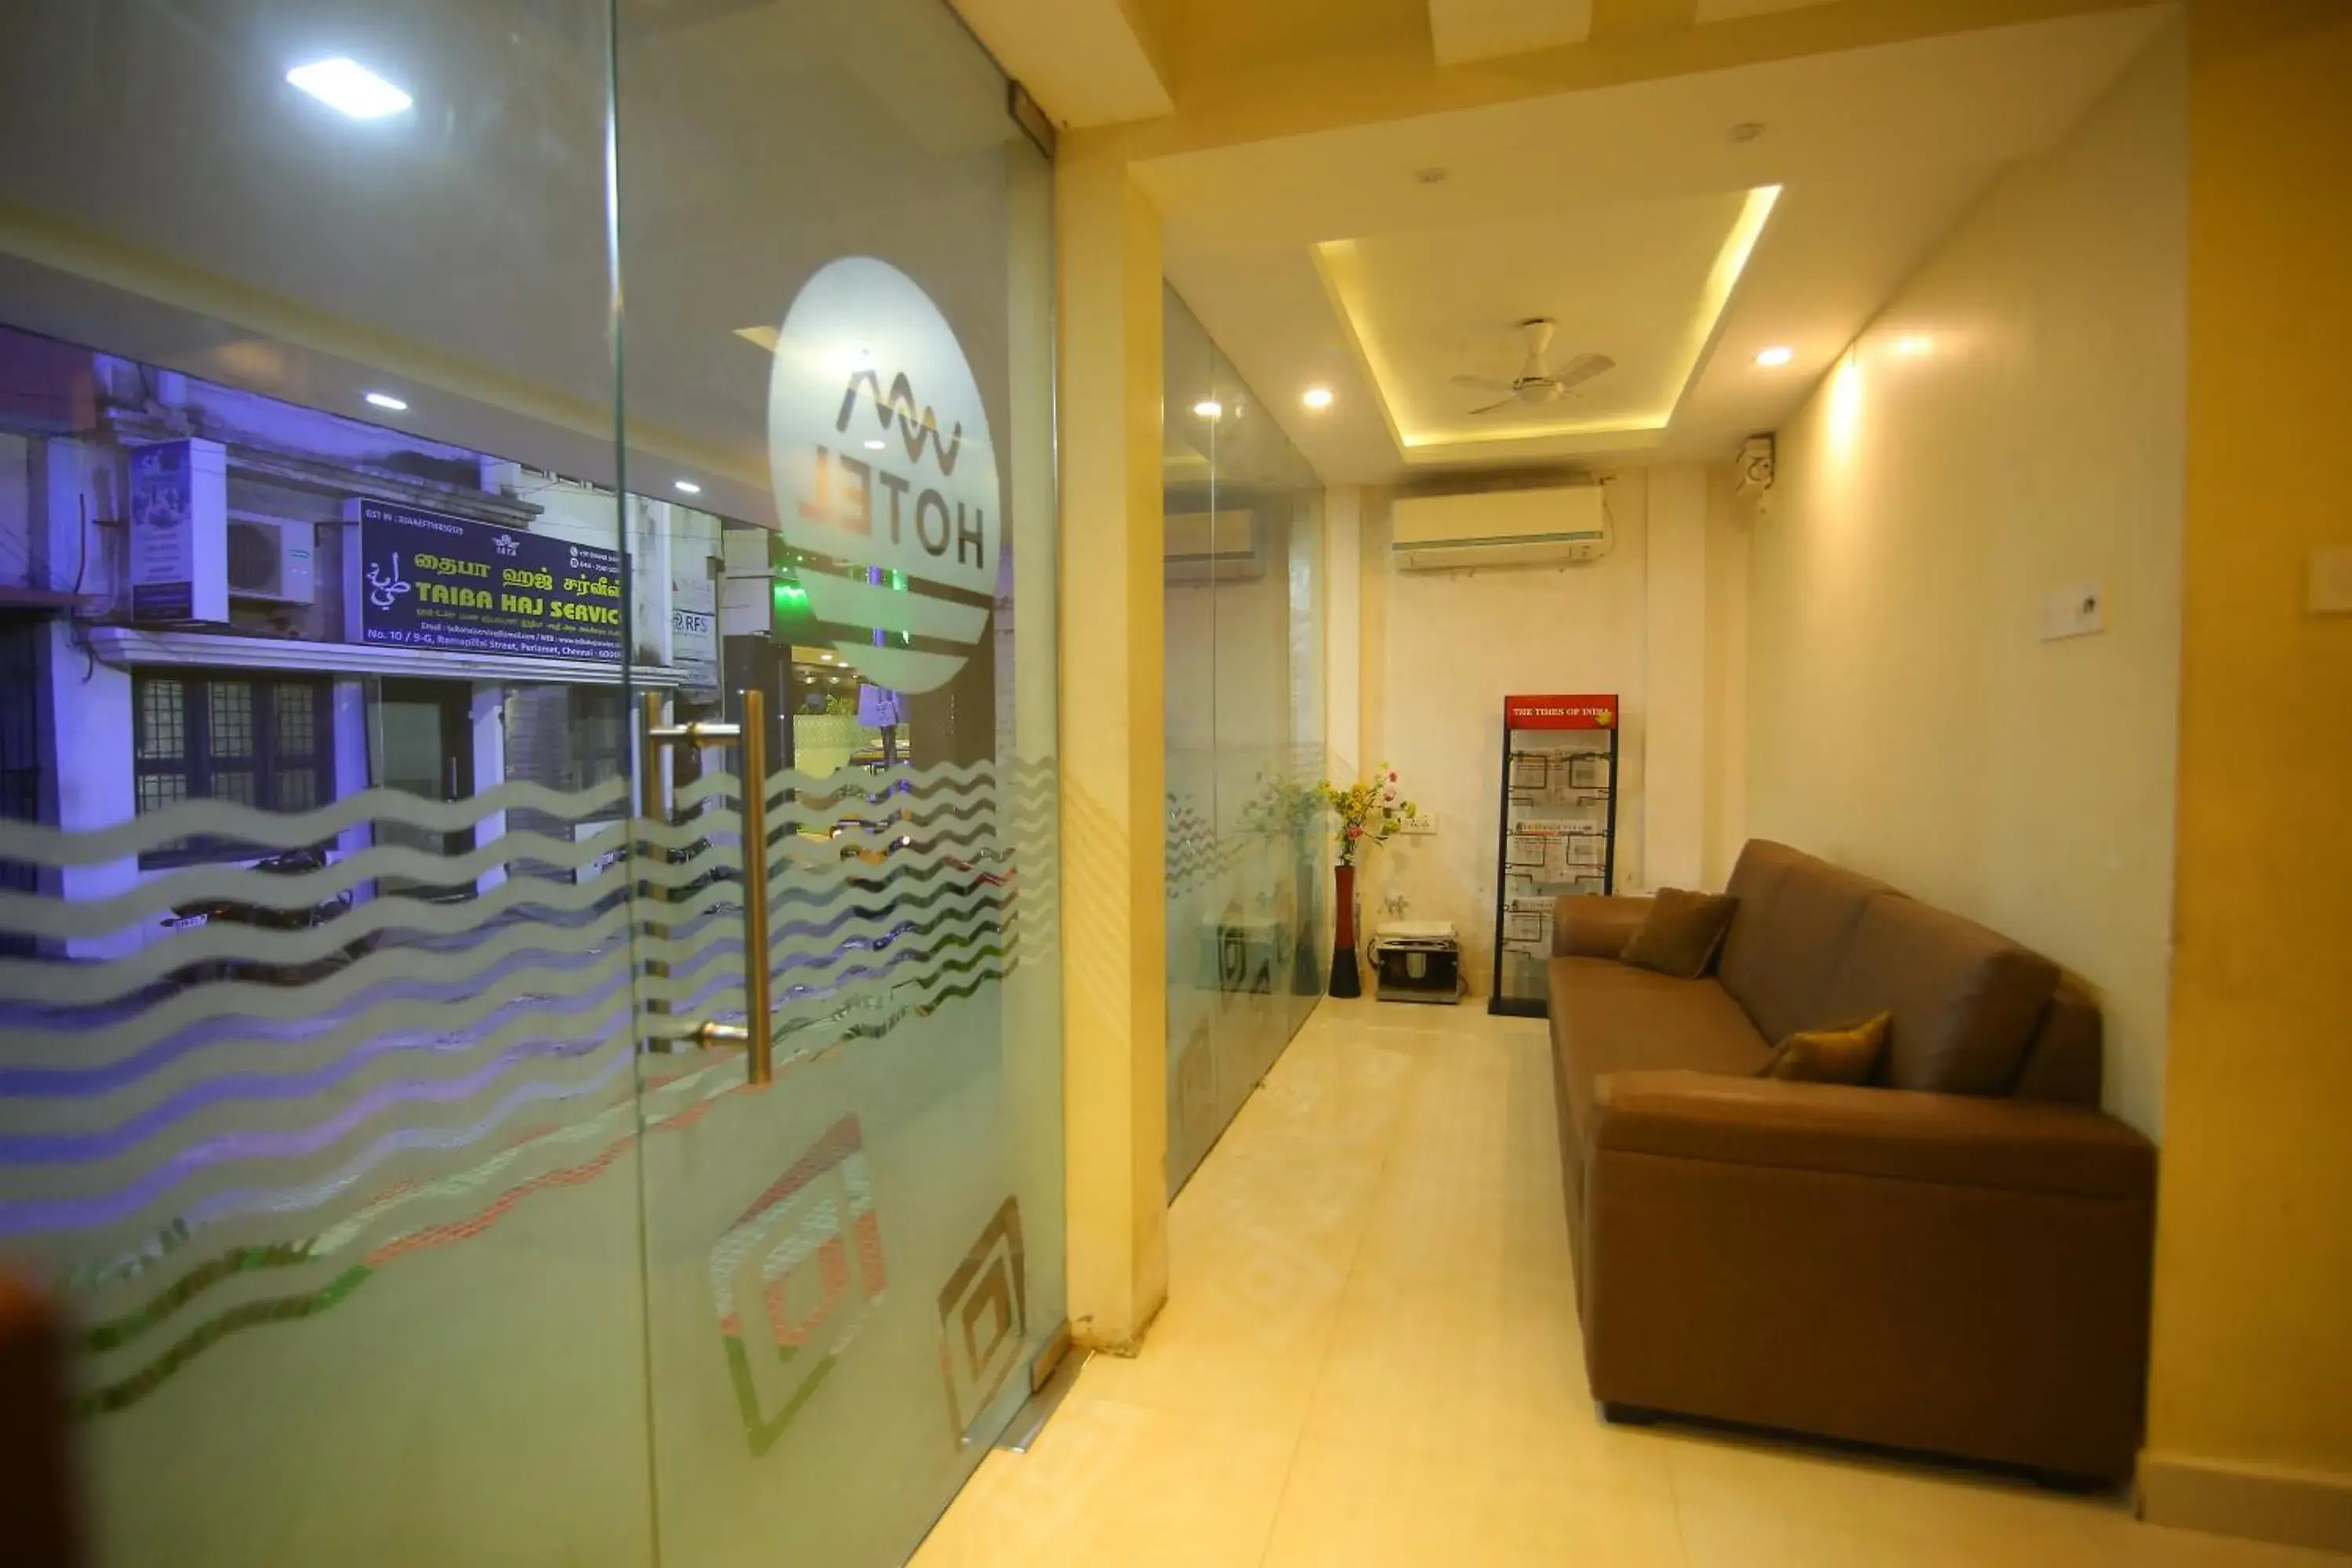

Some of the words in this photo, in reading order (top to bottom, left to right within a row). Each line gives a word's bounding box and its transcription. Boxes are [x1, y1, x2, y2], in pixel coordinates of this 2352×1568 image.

[414, 553, 492, 578] தைபா
[503, 566, 553, 590] ஹஜ்
[415, 581, 493, 609] TAIBA
[501, 593, 543, 615] HAJ
[550, 601, 620, 625] SERVIC
[685, 615, 710, 633] RFS
[367, 628, 387, 640] No.
[390, 631, 403, 641] 10
[561, 646, 593, 657] Chennai
[1512, 707, 1533, 717] THE
[1535, 707, 1565, 717] TIMES
[1566, 708, 1580, 717] OF
